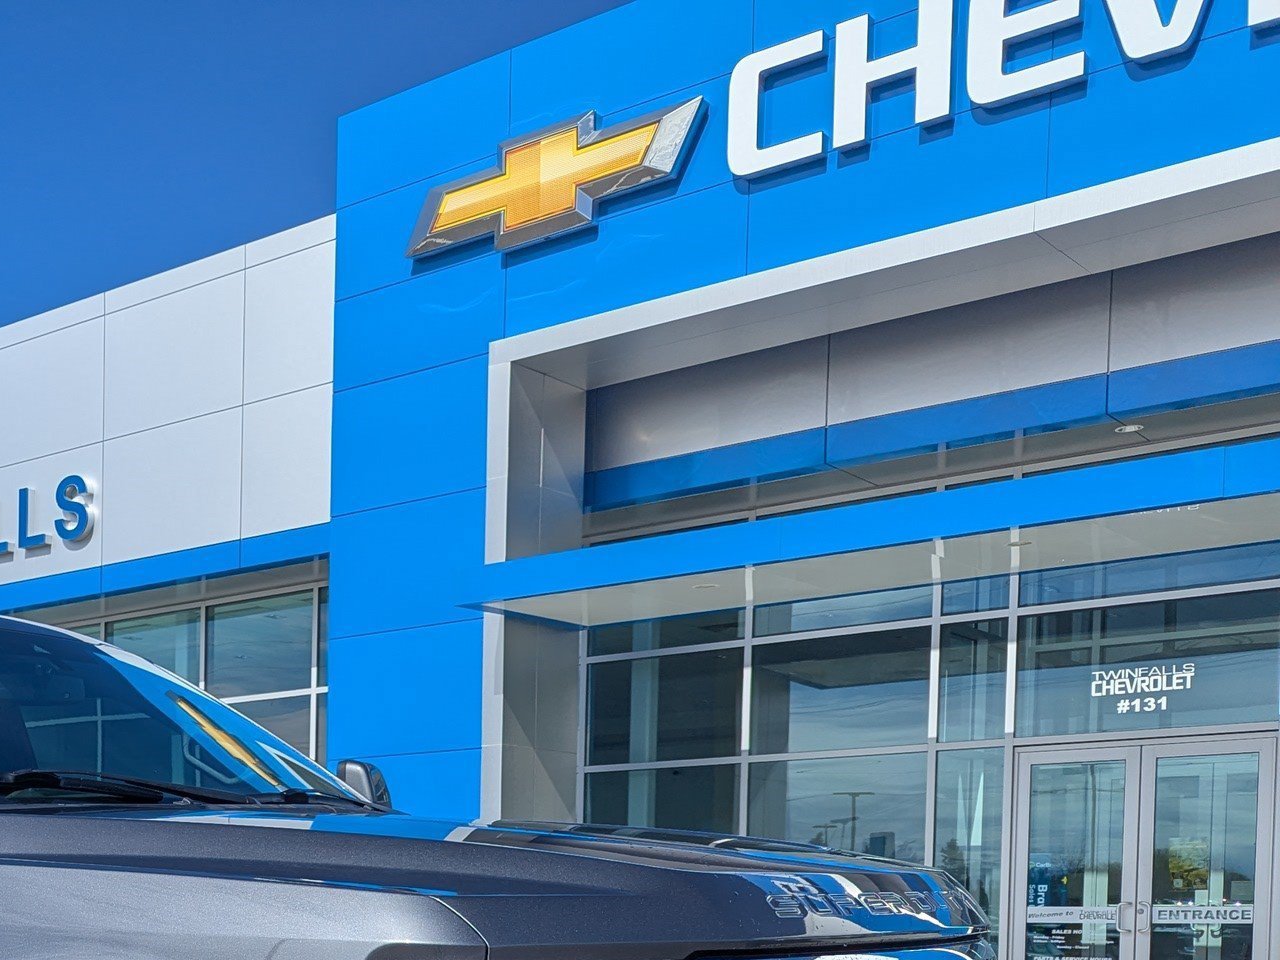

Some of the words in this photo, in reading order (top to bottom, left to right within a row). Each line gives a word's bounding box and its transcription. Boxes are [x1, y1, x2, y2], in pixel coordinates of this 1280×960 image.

[728, 0, 1280, 179] CHE
[1091, 663, 1195, 681] TWINFALLS
[1091, 672, 1195, 697] CHEVROLET
[1116, 696, 1167, 714] #131
[766, 891, 917, 918] SUPER
[1028, 911, 1064, 919] Welcome
[1079, 912, 1117, 920] CHEVROLE
[1157, 909, 1252, 920] ENTRANCE
